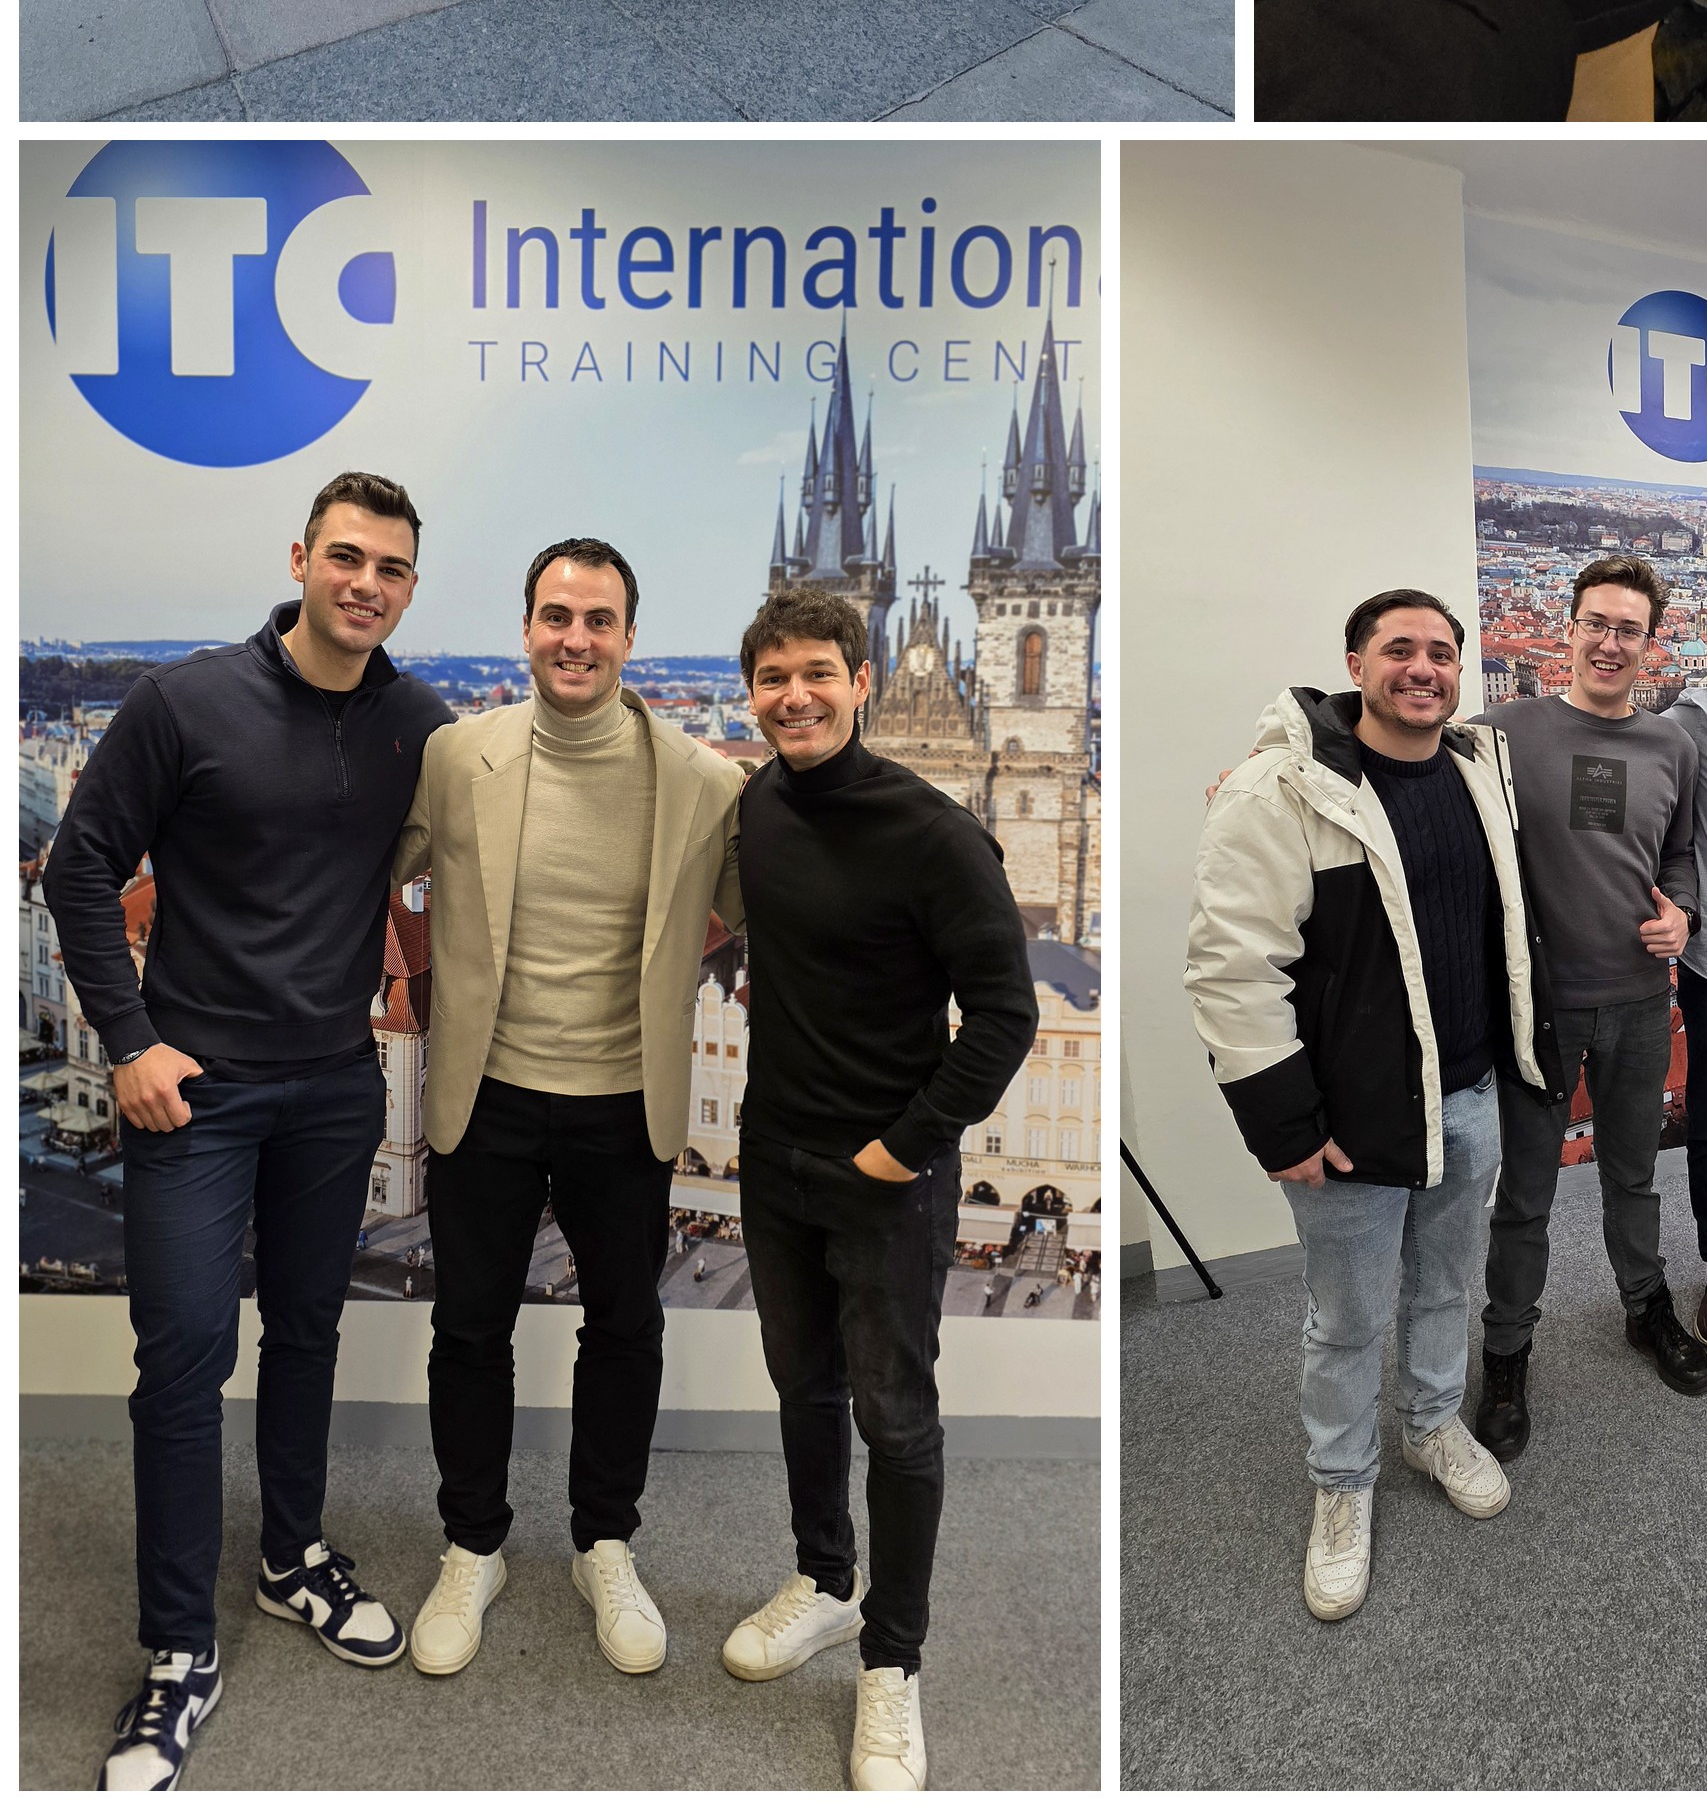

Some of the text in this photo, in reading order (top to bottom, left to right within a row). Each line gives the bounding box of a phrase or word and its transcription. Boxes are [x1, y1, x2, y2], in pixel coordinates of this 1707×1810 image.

[50, 194, 397, 382] ITC
[471, 197, 1101, 310] Internation
[467, 339, 838, 384] TRAINING
